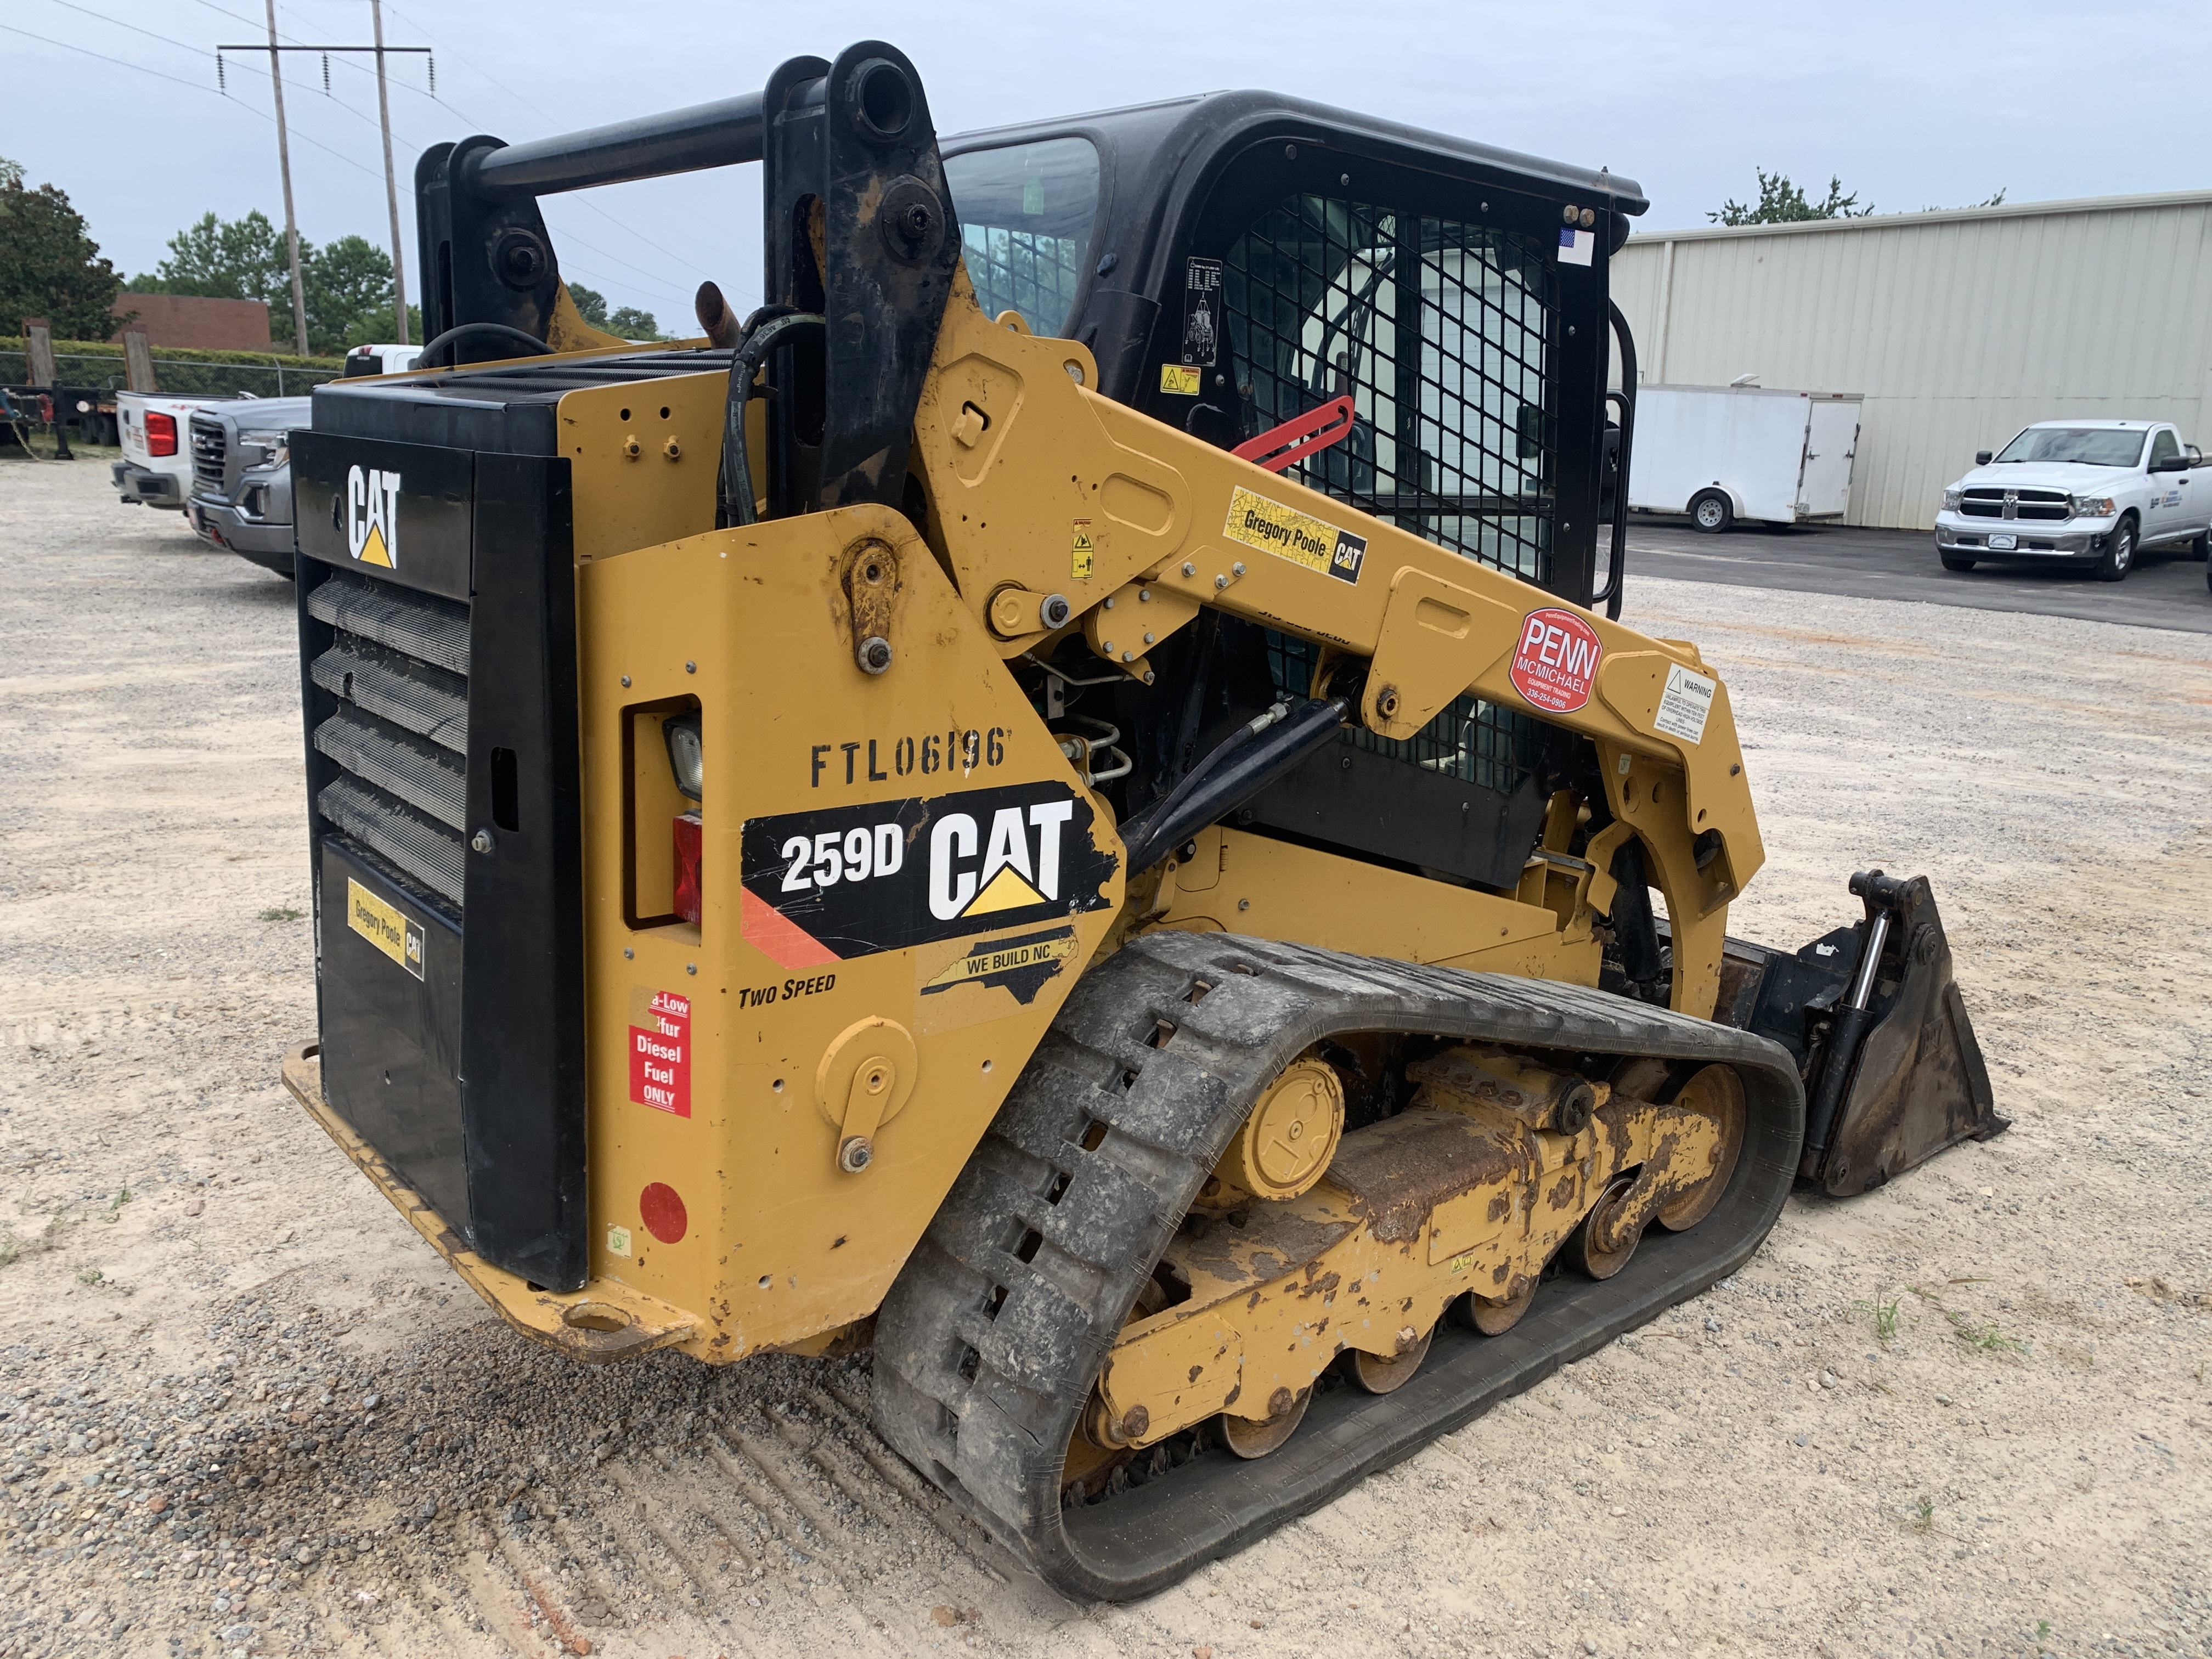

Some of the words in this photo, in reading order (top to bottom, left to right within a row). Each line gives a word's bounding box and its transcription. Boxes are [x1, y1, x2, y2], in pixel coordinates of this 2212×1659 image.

[348, 465, 400, 569] CAT
[1244, 510, 1292, 546] Gregory
[1293, 529, 1326, 557] Poole
[1334, 543, 1362, 571] CAT
[1522, 617, 1599, 680] PENN
[1516, 656, 1586, 695] MCMICHAEL
[1527, 677, 1553, 692] EQUIPMENT
[1552, 687, 1571, 699] TRADING
[1684, 679, 1712, 698] WARNING
[1527, 688, 1566, 709] 336-254-0906
[1660, 716, 1672, 725] Contact
[810, 726, 1004, 788] FTL06196
[781, 823, 903, 893] 259D
[929, 799, 1073, 921] CAT
[356, 899, 380, 935] Gregory
[381, 917, 400, 947] Poole
[406, 932, 422, 964] CAT
[967, 958, 989, 975] WE
[992, 948, 1029, 970] BUILD
[1032, 944, 1051, 961] NC
[637, 1035, 682, 1064] Diesel
[644, 1061, 674, 1086] Fuel
[644, 1085, 675, 1107] ONLY
